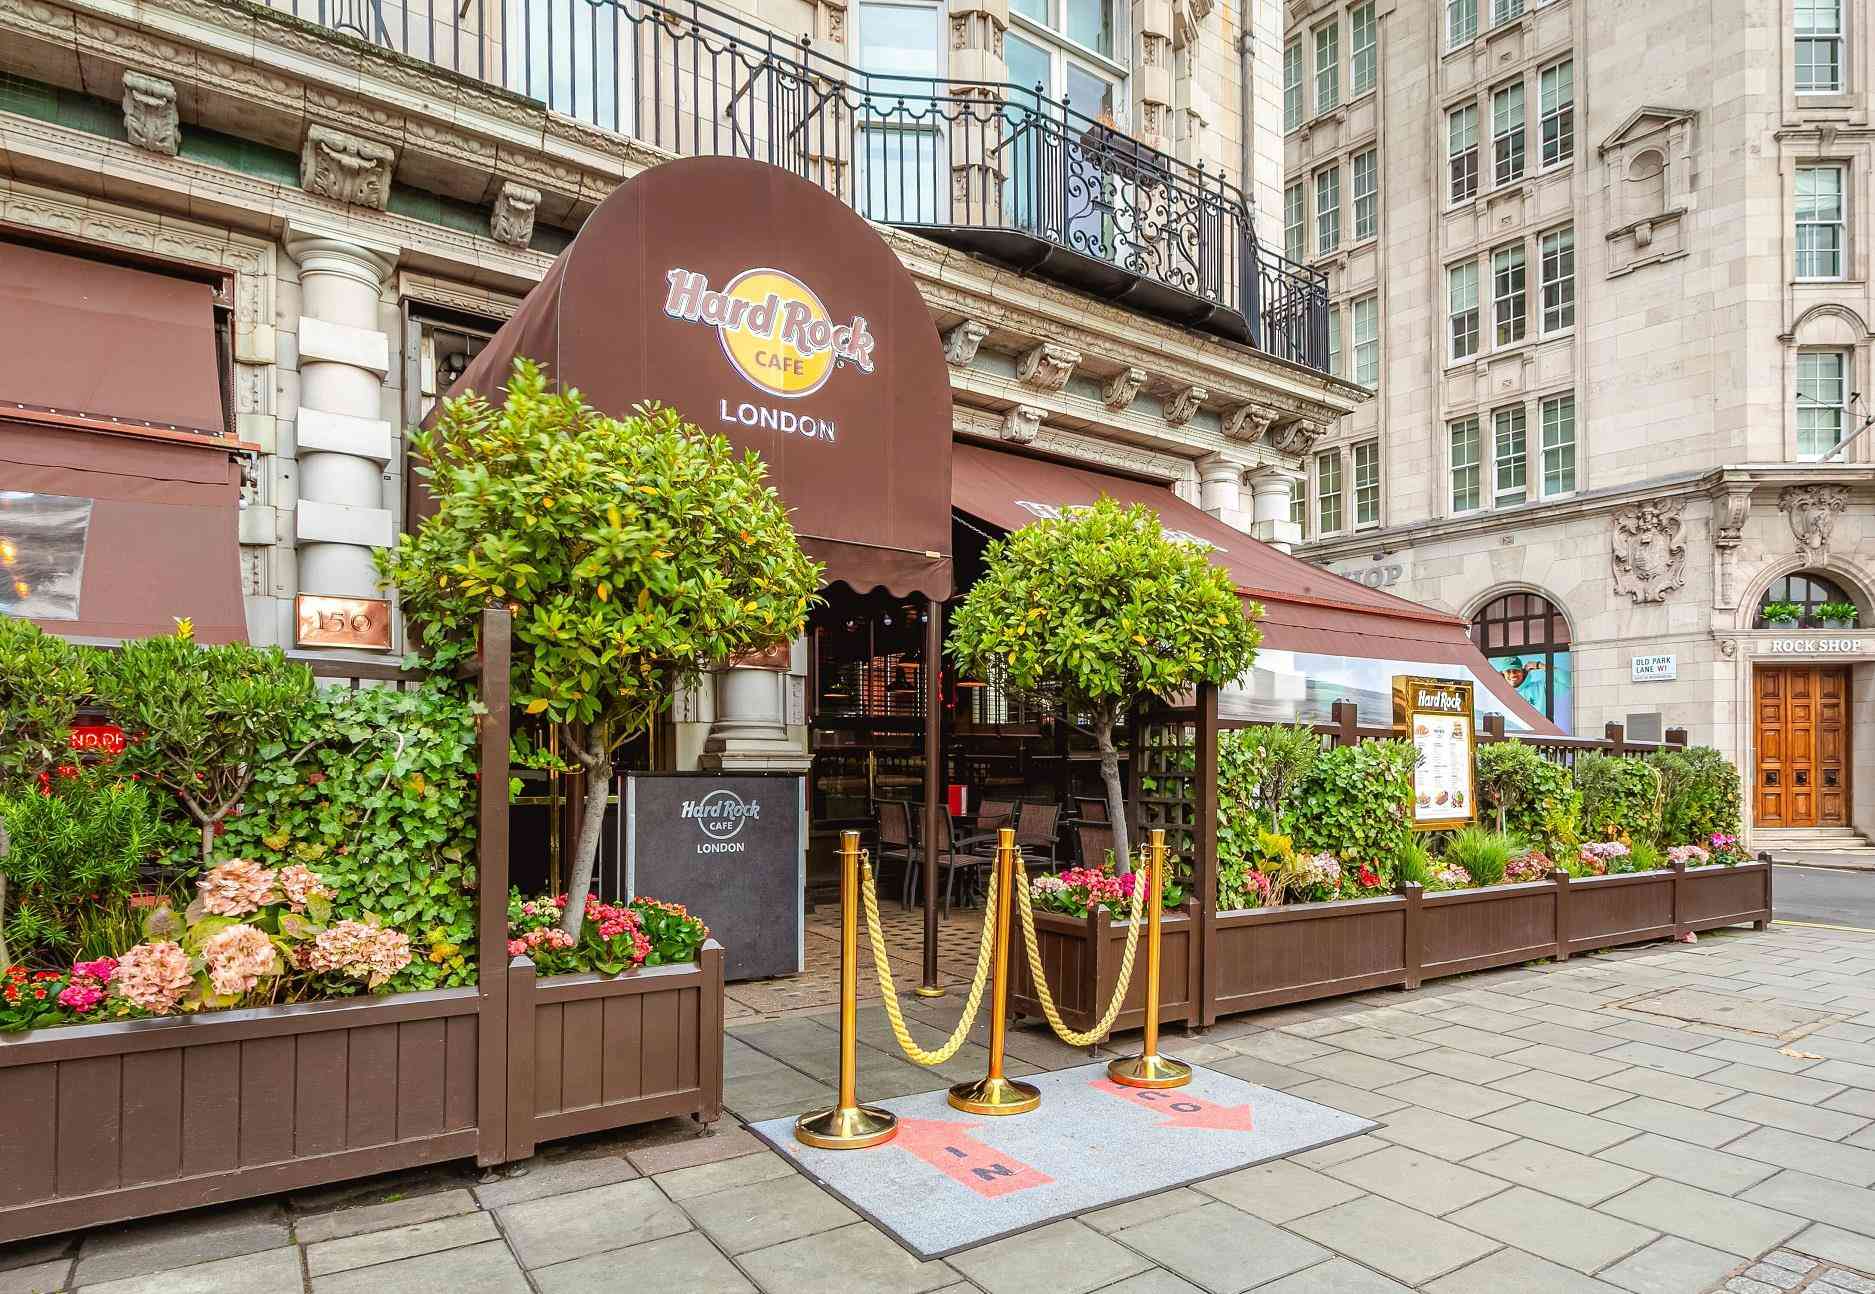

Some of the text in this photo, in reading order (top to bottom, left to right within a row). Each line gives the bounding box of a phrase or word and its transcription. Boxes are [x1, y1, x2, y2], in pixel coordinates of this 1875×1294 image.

[664, 267, 875, 374] Hard Rock
[754, 349, 806, 377] CAFE
[719, 399, 837, 441] LONDON
[315, 607, 373, 633] 150
[1771, 638, 1862, 653] ROCK SHOP
[1635, 656, 1671, 666] OLD PARK
[1636, 665, 1655, 673] LANE
[1418, 689, 1462, 712] Hard Rock
[681, 800, 760, 821] Hard Rock
[709, 821, 734, 831] CAFE
[696, 842, 745, 854] LONDON
